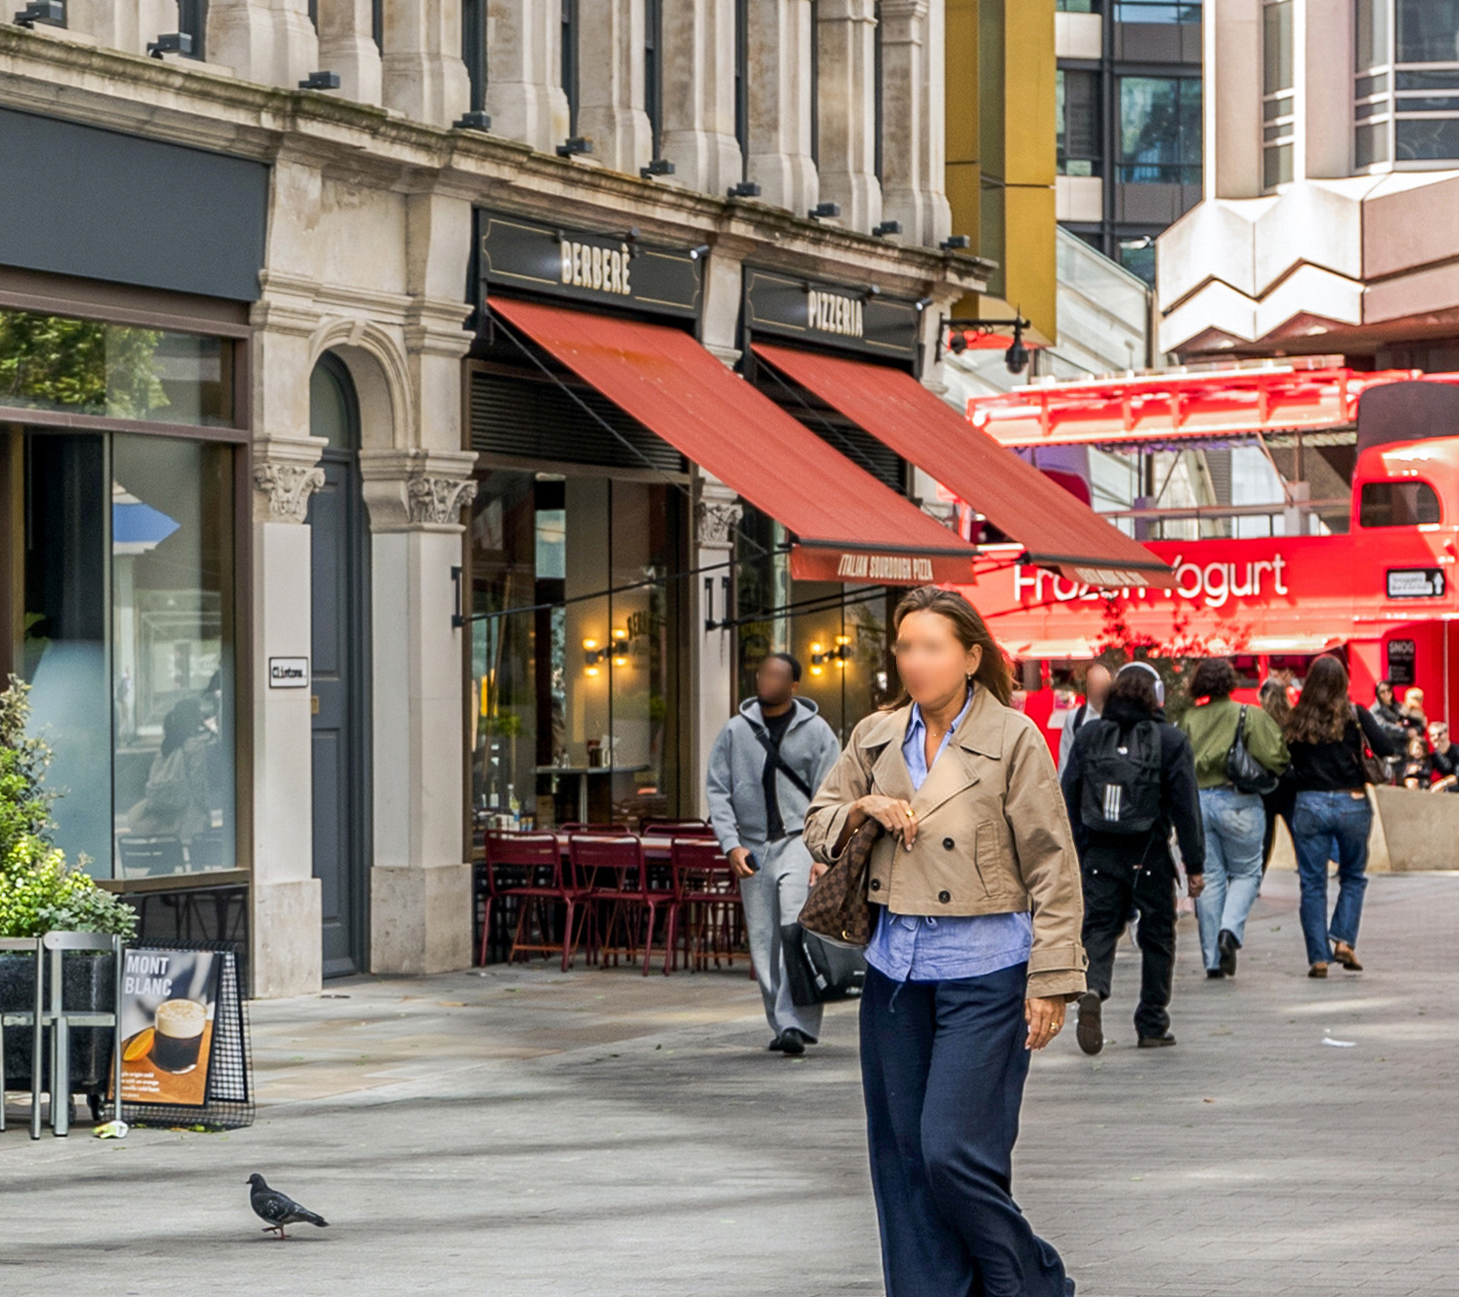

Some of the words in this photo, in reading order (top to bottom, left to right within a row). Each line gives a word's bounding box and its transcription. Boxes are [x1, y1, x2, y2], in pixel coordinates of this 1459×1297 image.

[807, 289, 864, 338] PIZZERIA
[912, 558, 934, 580] PIZZA
[1014, 564, 1145, 602] Fro
[126, 955, 170, 976] MONT
[124, 977, 173, 997] BLANC
